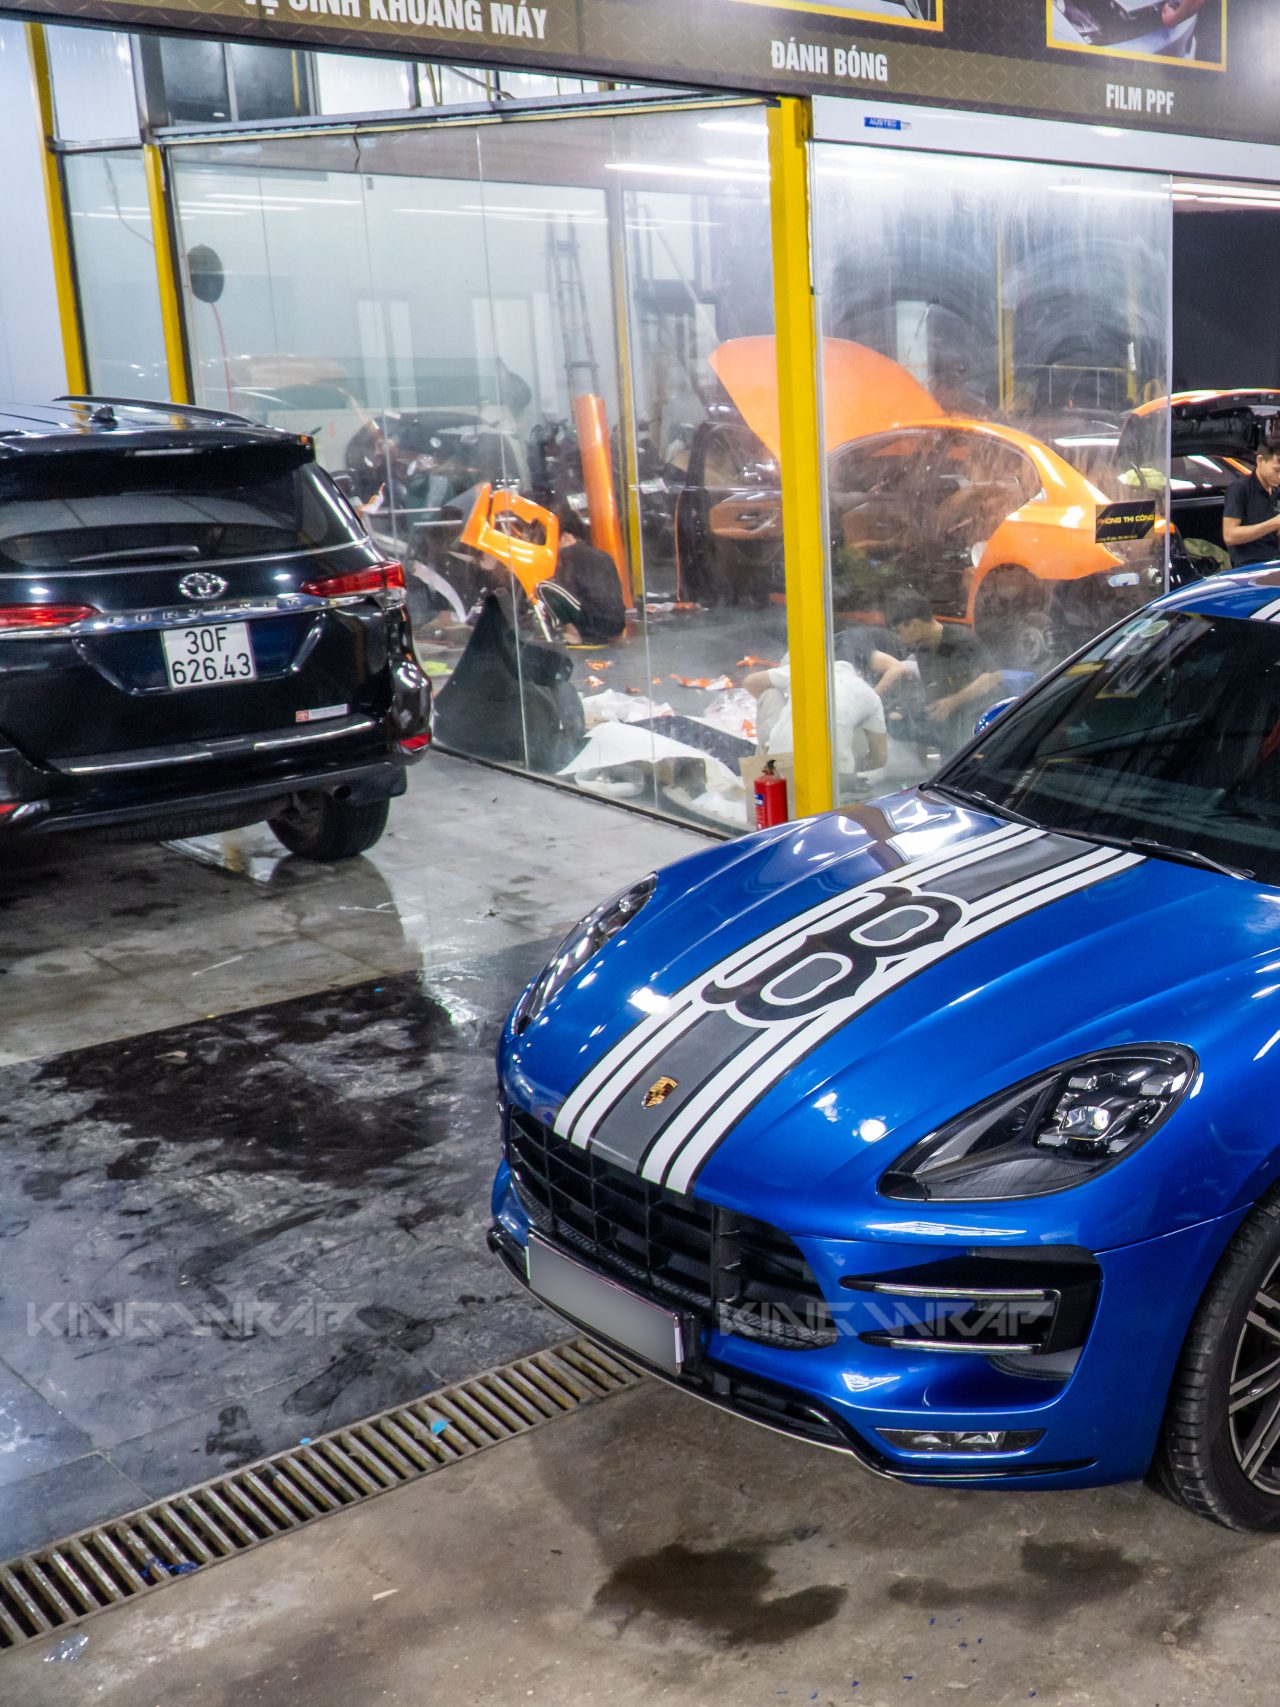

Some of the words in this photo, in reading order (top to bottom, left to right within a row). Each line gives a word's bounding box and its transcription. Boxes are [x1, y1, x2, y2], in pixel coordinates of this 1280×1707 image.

[370, 0, 483, 32] KHOANG
[489, 0, 547, 39] MÁY
[771, 36, 829, 75] ĐÁNH
[834, 44, 888, 82] BÓNG
[1106, 83, 1141, 113] FILM
[1146, 86, 1174, 115] PPF
[184, 626, 228, 656] 30F
[171, 652, 251, 686] 626.43
